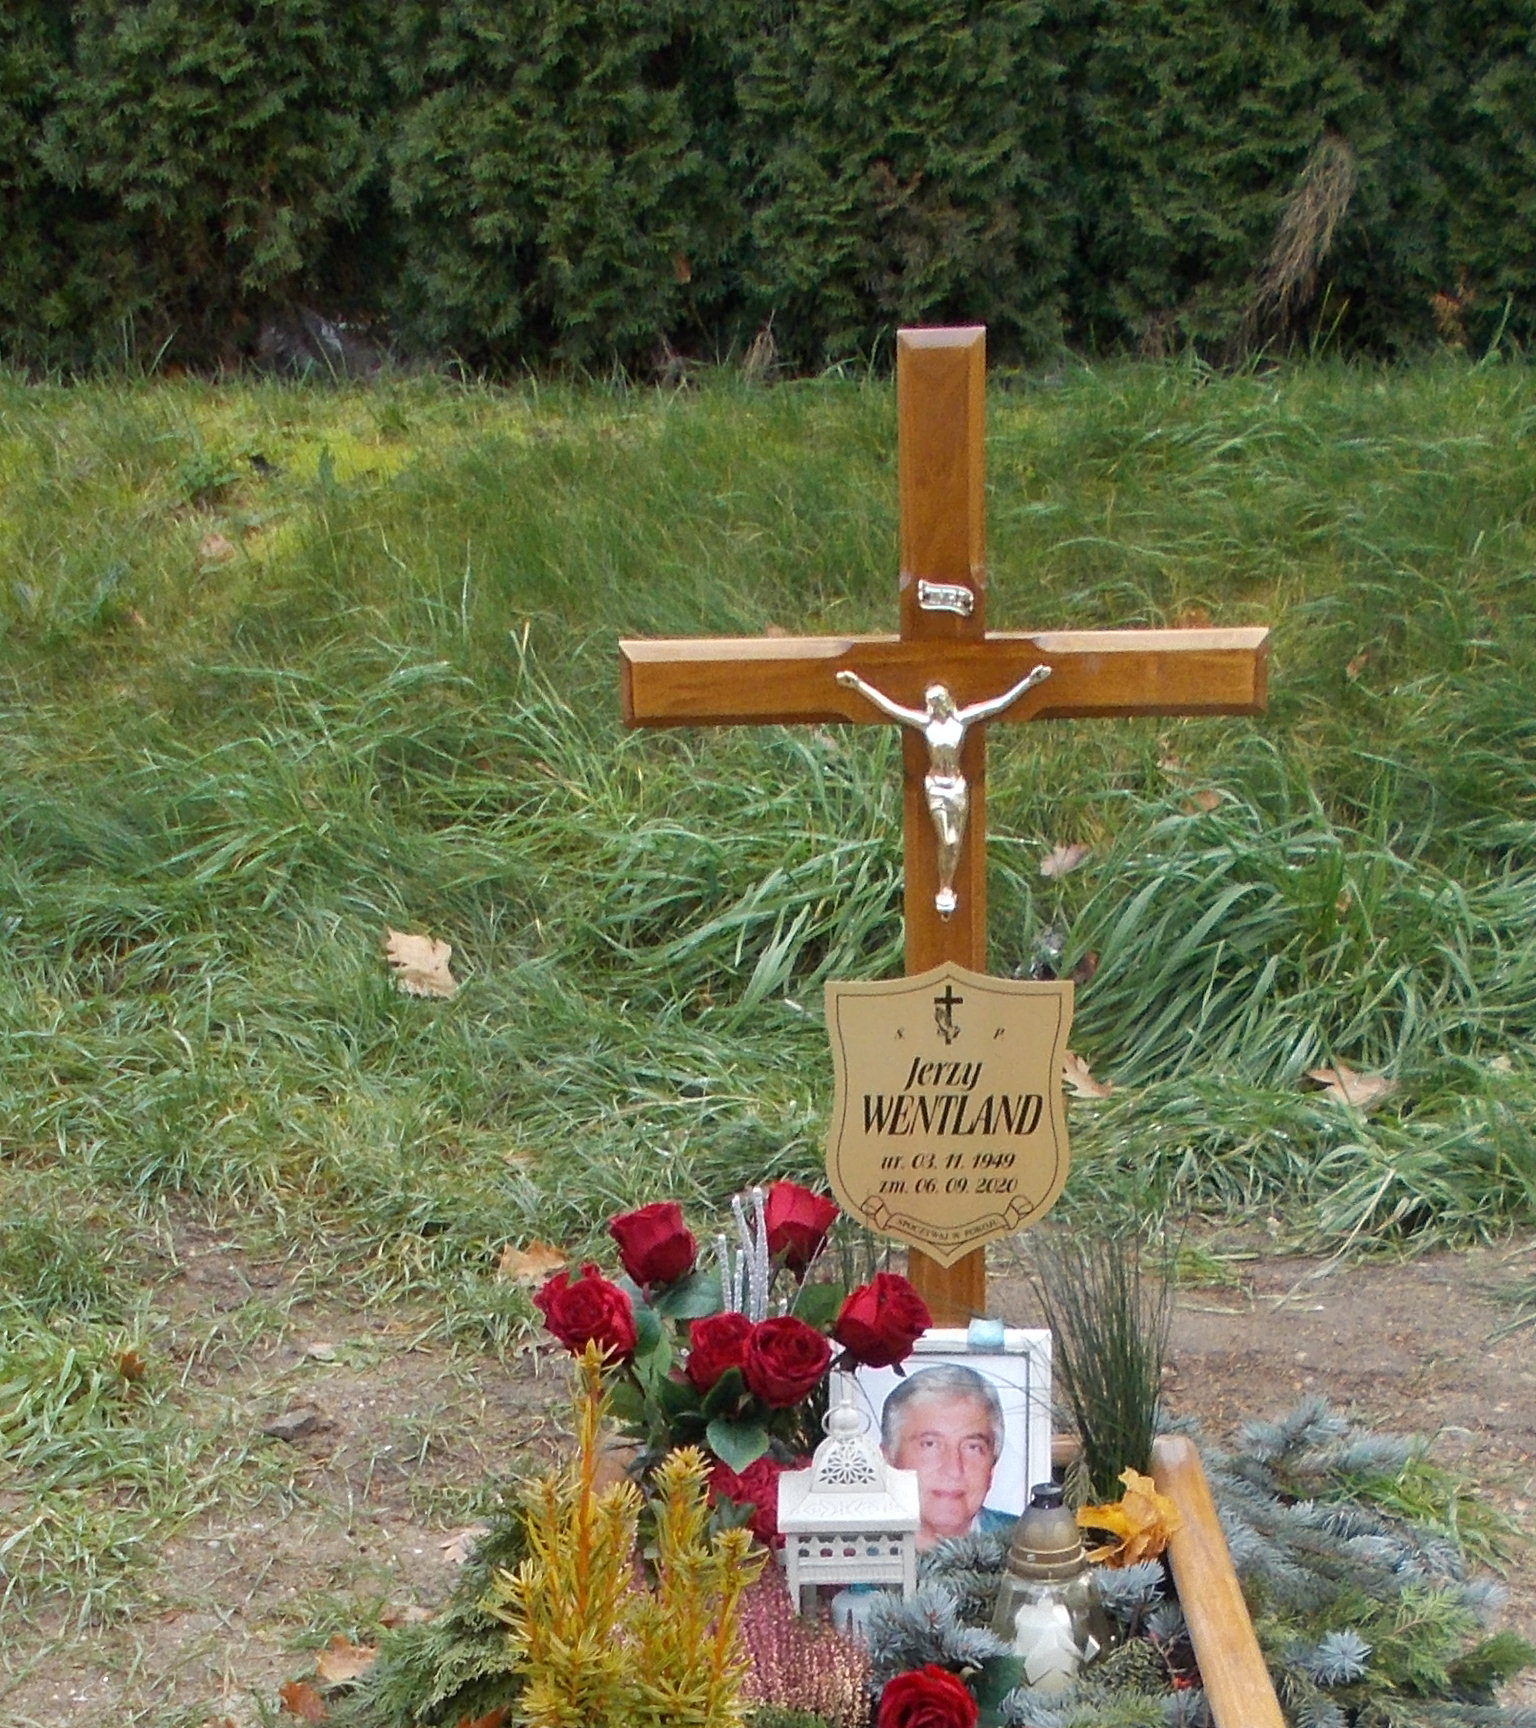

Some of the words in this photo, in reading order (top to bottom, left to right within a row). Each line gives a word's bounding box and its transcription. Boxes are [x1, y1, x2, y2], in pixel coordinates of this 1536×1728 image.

[903, 1056, 983, 1092] Jerzy
[863, 1093, 1044, 1136] WENTLAND
[880, 1153, 905, 1170] ur.
[911, 1152, 938, 1170] 03.
[945, 1152, 965, 1170] 11.
[972, 1152, 1016, 1170] 1949
[878, 1179, 908, 1194] zm.
[914, 1177, 939, 1194] 06.
[945, 1177, 969, 1194] 09.
[975, 1177, 1019, 1194] 2020
